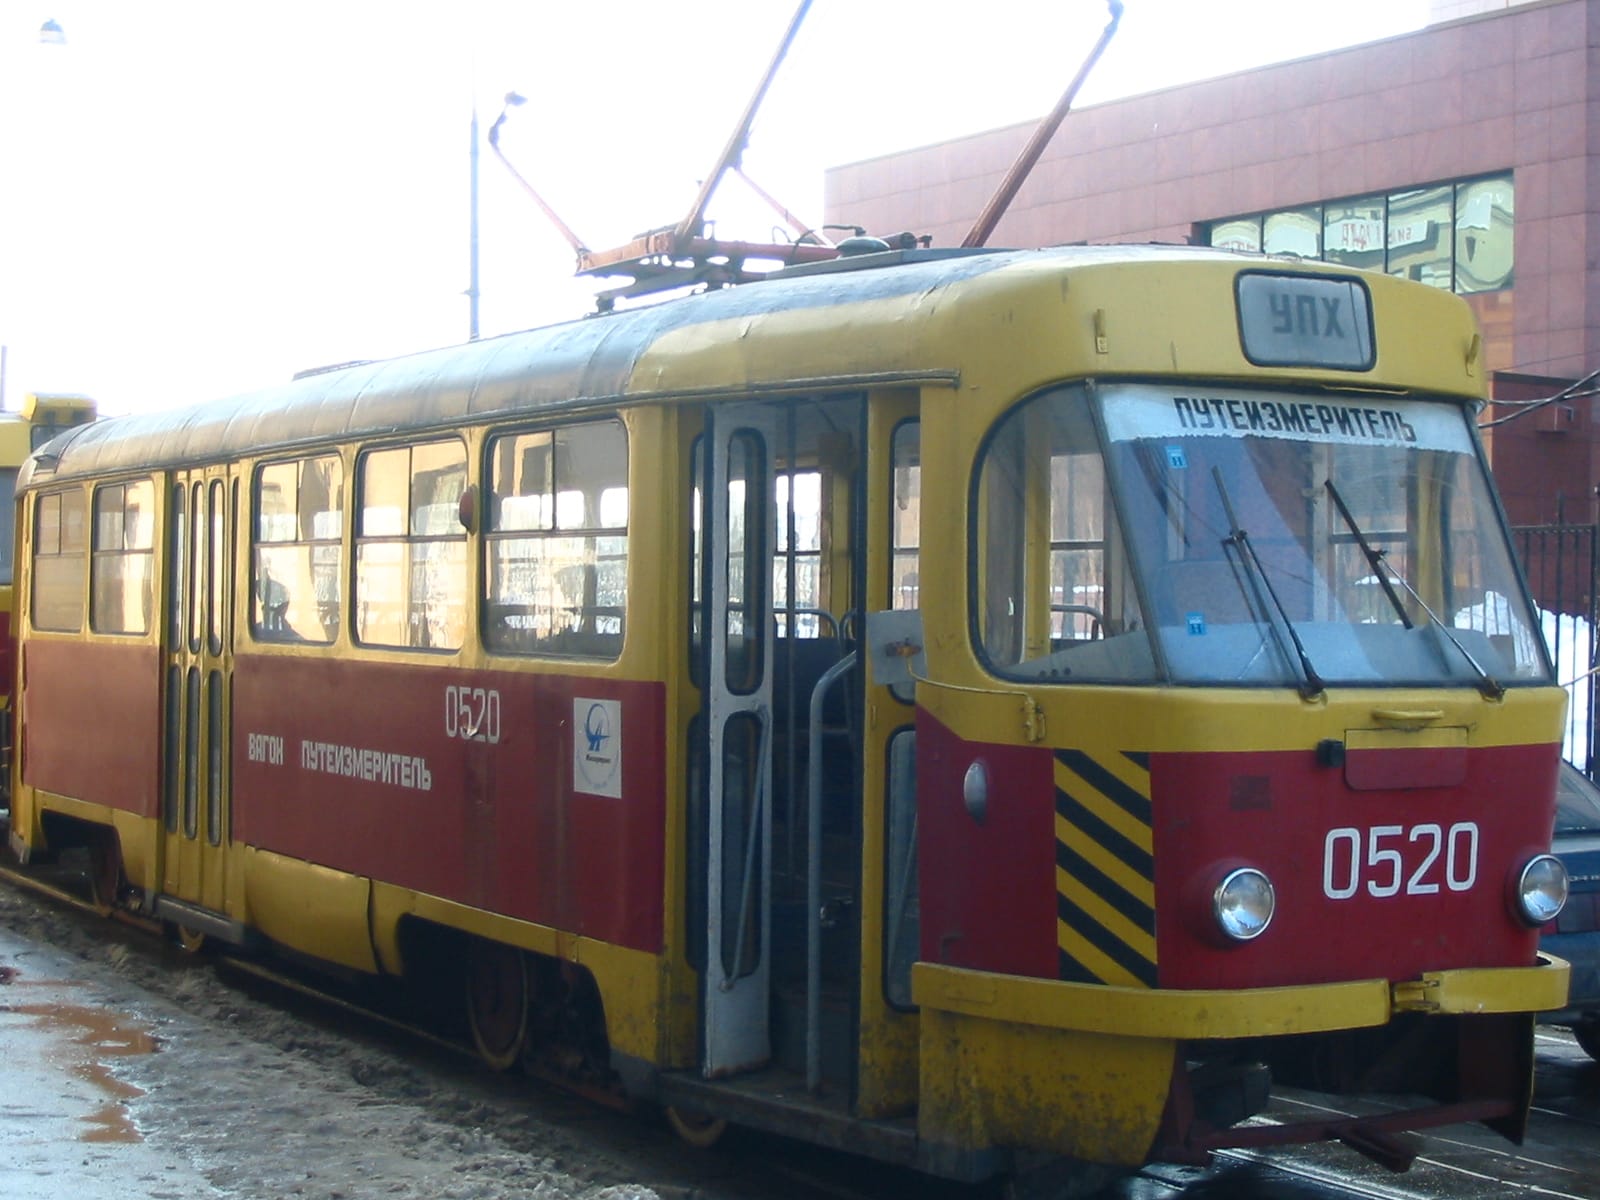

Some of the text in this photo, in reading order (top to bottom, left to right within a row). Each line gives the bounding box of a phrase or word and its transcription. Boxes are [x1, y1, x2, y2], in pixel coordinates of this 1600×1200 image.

[1269, 293, 1345, 338] УПХ
[1173, 397, 1417, 442] ПУТЕИЗМЕРИТЕЛЬ
[445, 686, 501, 744] 0520
[248, 733, 432, 791] ВАГОН ПУТЕИЗМЕРИТЕЛЬ
[1322, 821, 1480, 900] 0520
